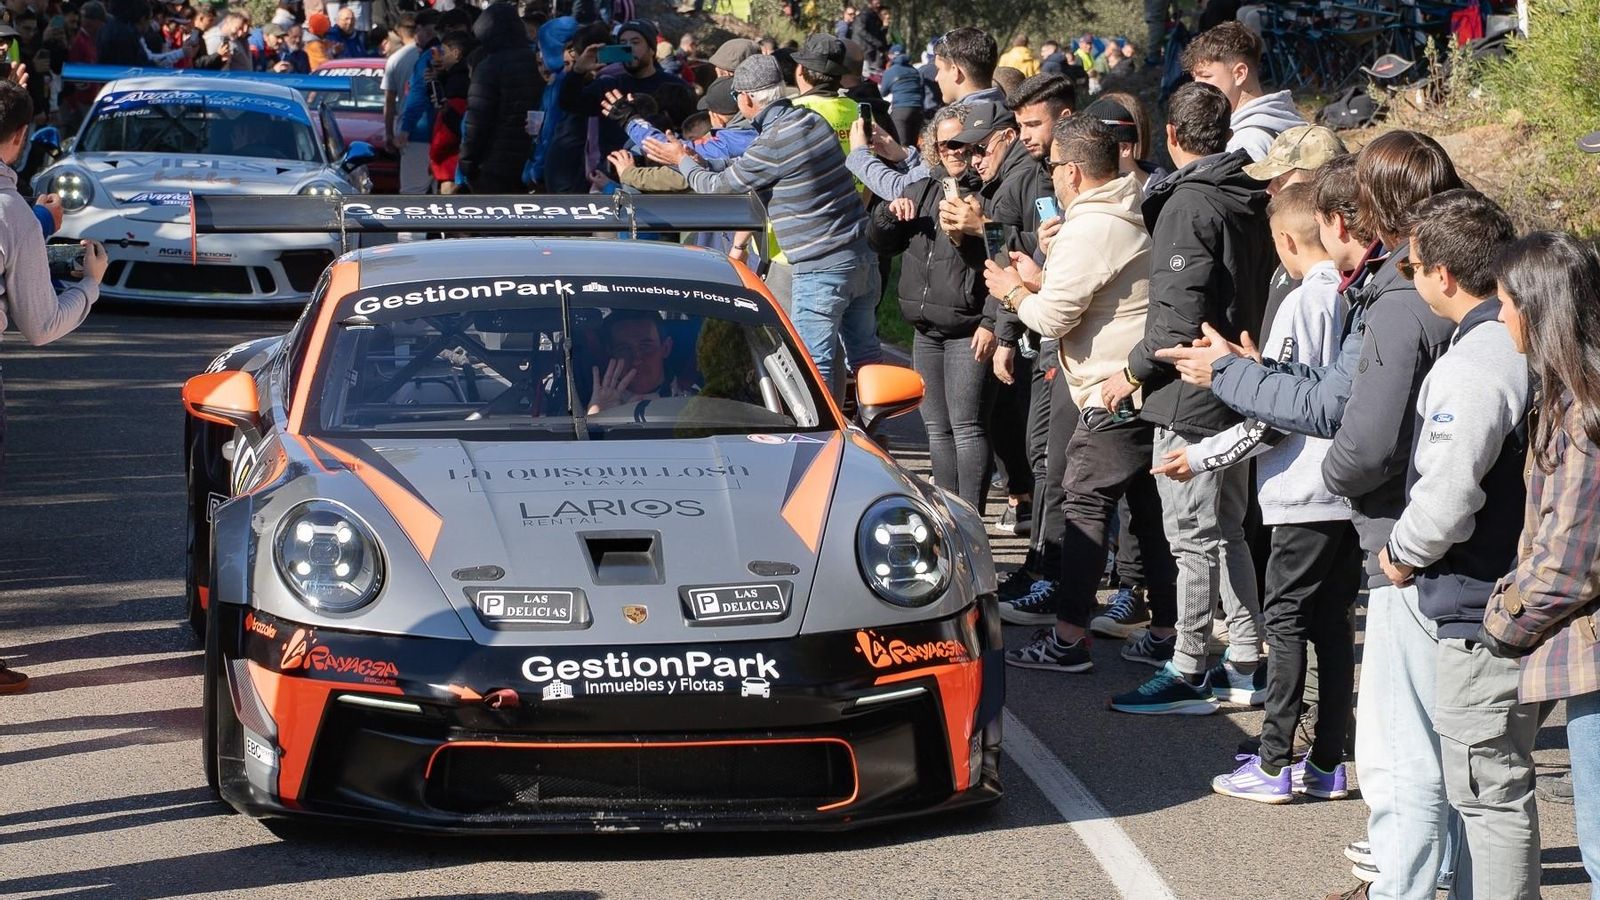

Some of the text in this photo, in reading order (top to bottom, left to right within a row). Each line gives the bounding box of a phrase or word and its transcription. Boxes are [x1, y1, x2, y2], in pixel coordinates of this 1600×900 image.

[114, 109, 151, 118] Rueda
[344, 203, 614, 216] GestionPark
[159, 247, 182, 256] AGR
[354, 279, 576, 315] GestionPark
[612, 284, 731, 304] Inmuebles y Flotas
[1280, 338, 1295, 362] KEL
[1219, 437, 1254, 466] KELME
[519, 499, 705, 519] LARIOS
[523, 516, 603, 527] RENTAL
[523, 594, 549, 603] LAS
[734, 589, 758, 599] LAS
[506, 606, 567, 618] DELICIAS
[722, 600, 780, 613] DELICIAS
[521, 651, 780, 683] GestionPark
[585, 677, 725, 695] Inmuebles y Flotas
[247, 739, 261, 759] EBC
